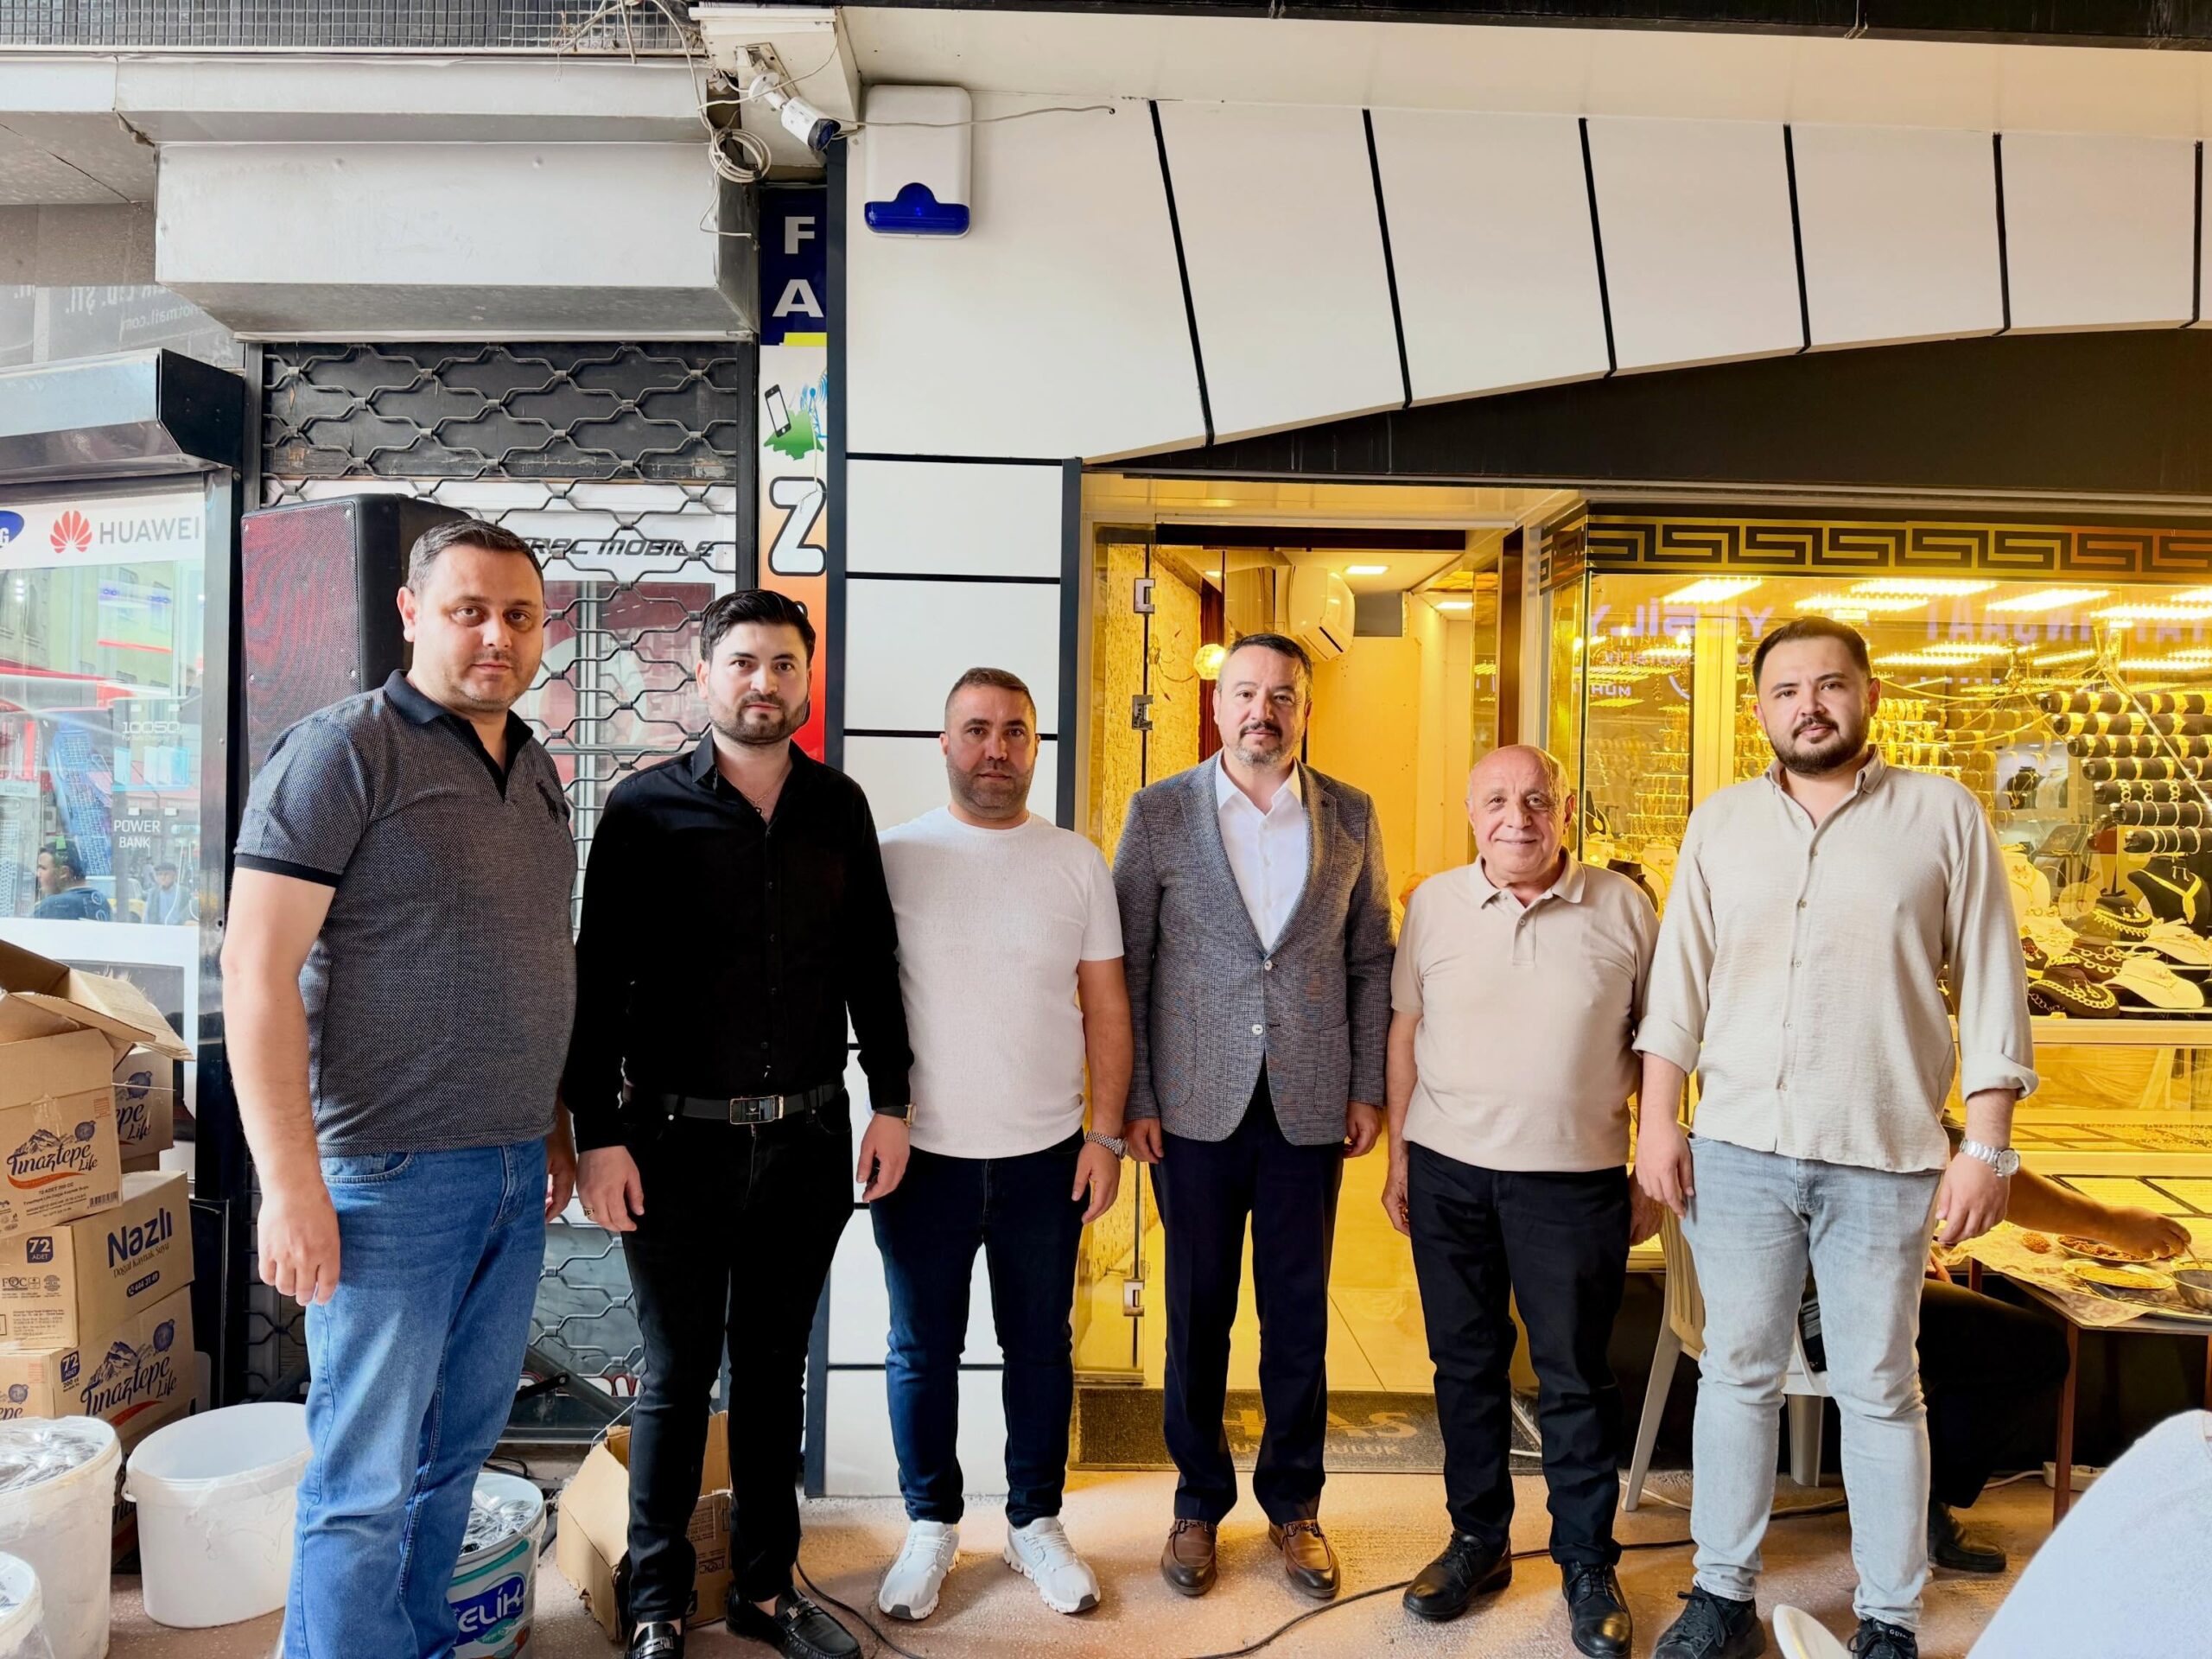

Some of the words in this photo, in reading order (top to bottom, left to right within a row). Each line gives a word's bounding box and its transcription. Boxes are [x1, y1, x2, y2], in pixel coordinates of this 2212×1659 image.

[99, 517, 200, 544] HUAWEI
[113, 820, 161, 833] POWER
[119, 836, 150, 849] BANK
[78, 1154, 98, 1172] Life
[29, 1238, 51, 1254] 72
[107, 1207, 173, 1268] Nazlı
[62, 1353, 79, 1372] 72
[156, 1369, 177, 1398] Life
[453, 1582, 522, 1633] ELİK
